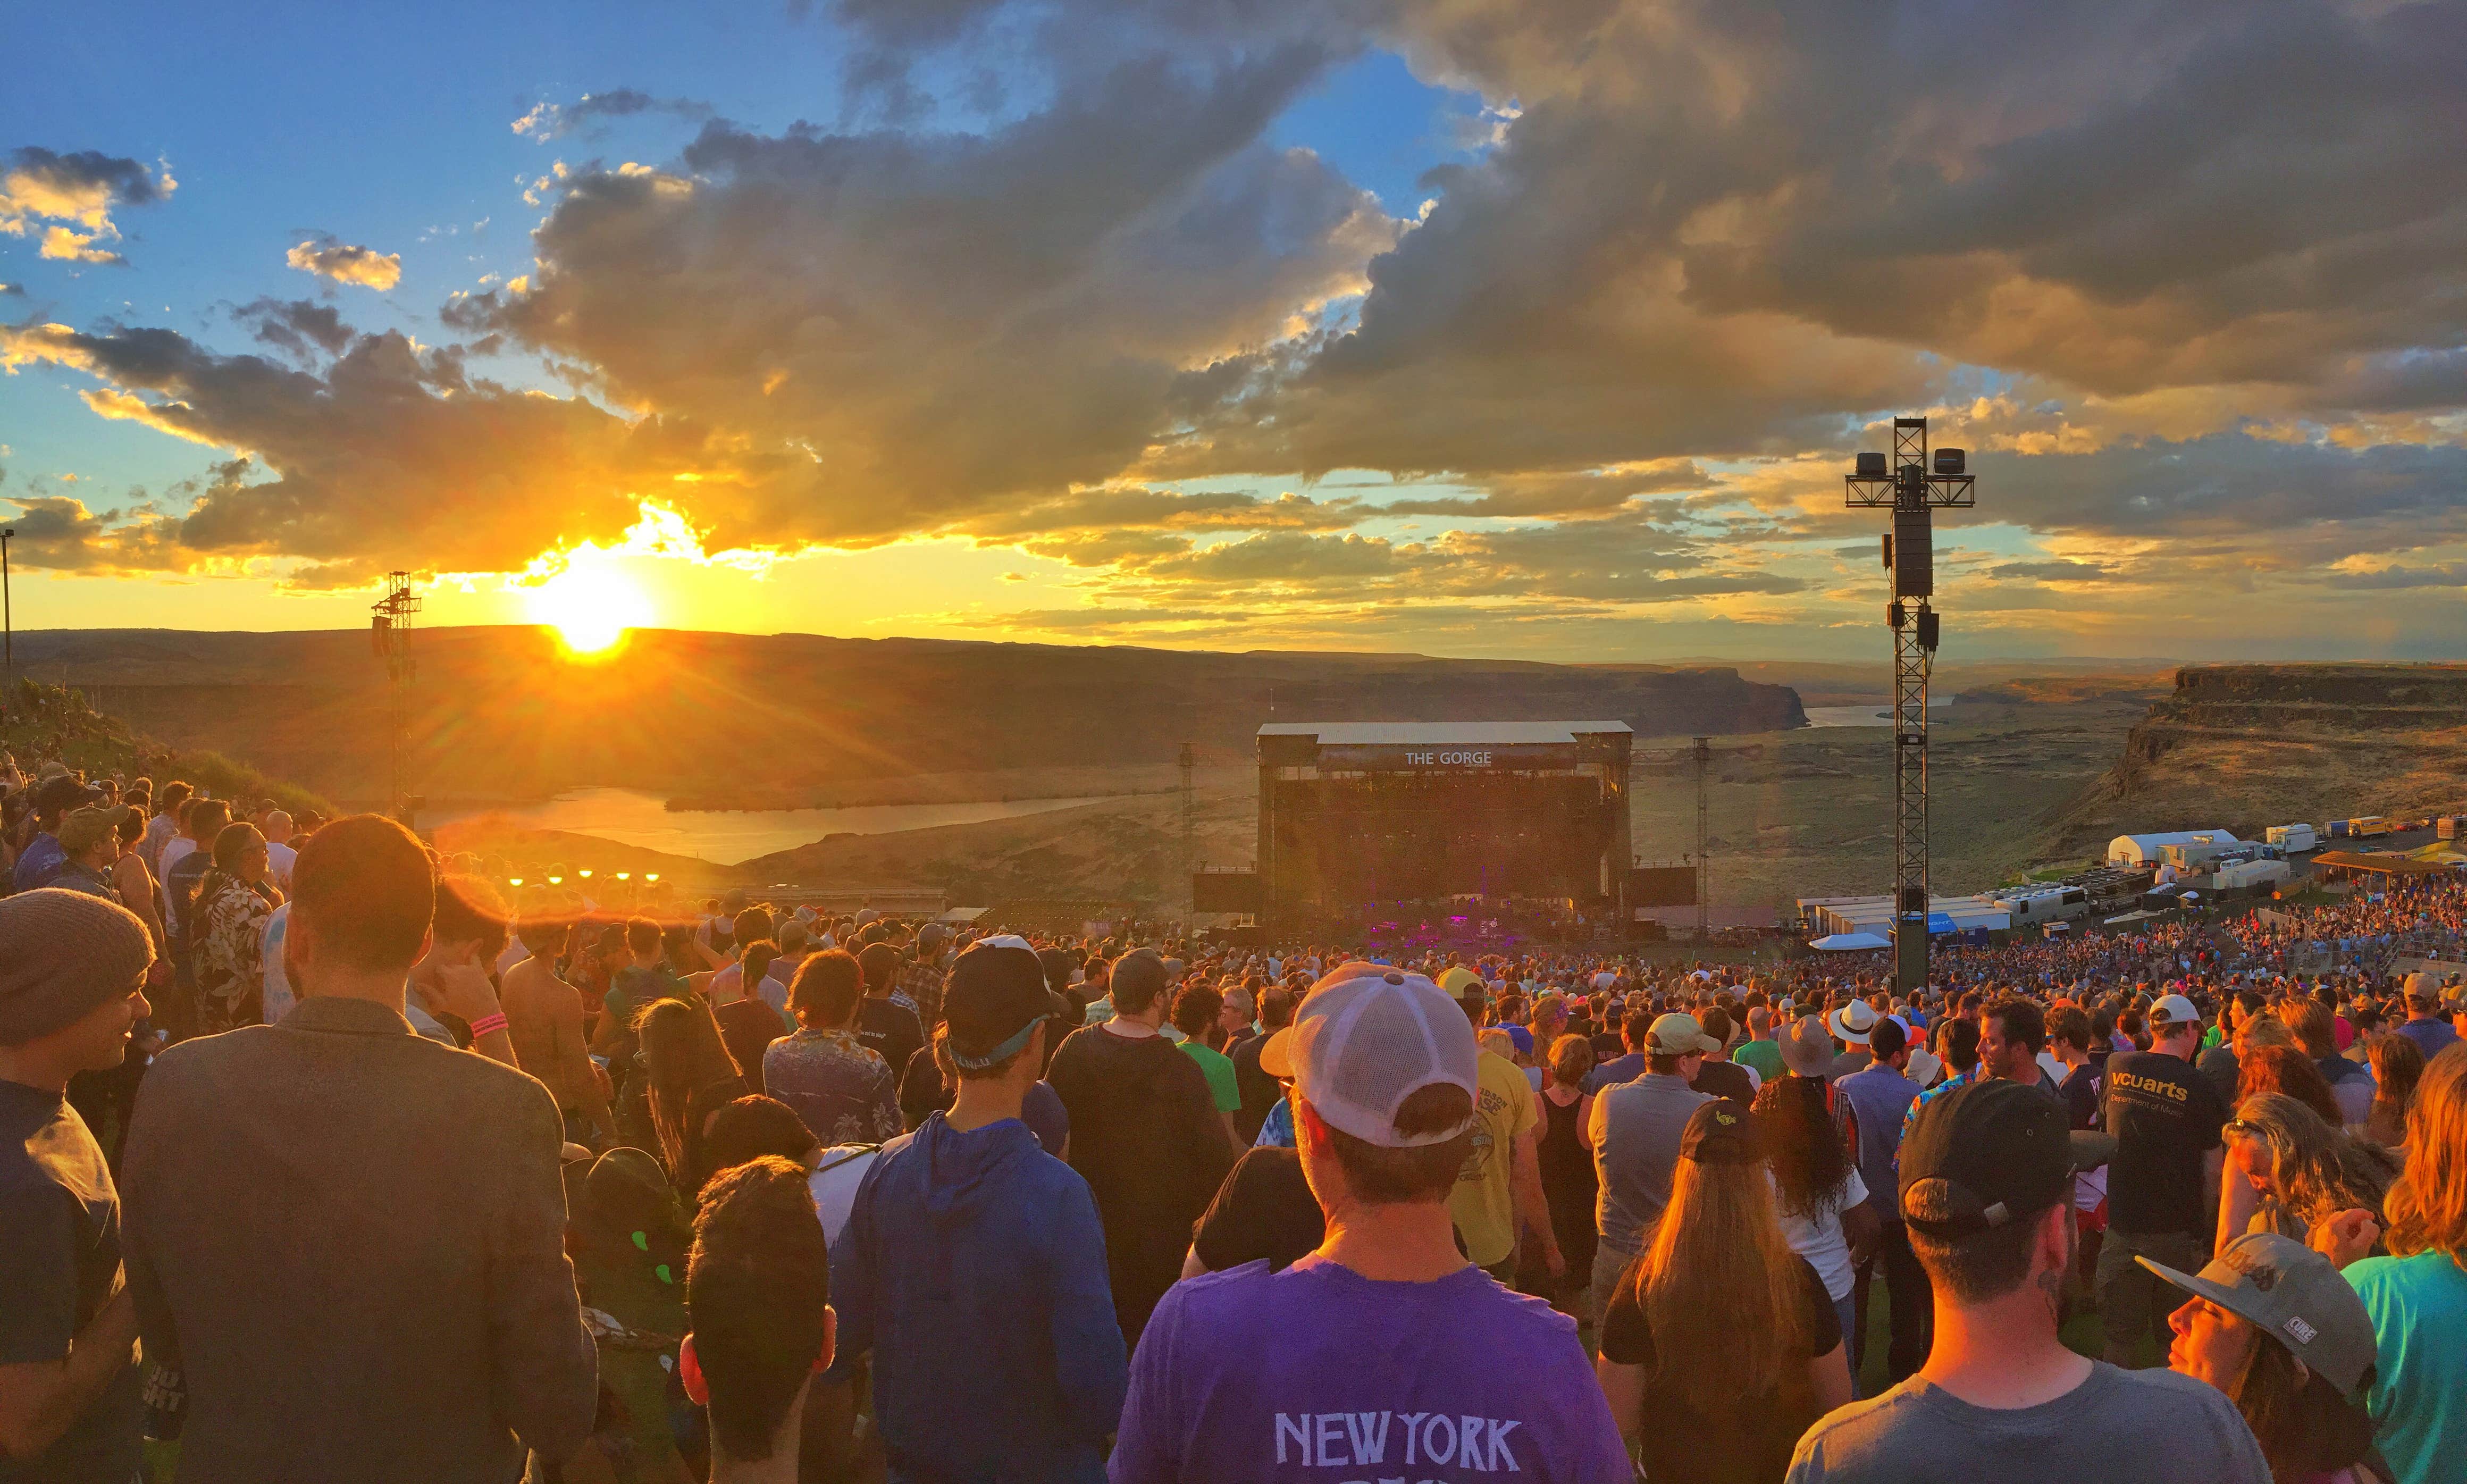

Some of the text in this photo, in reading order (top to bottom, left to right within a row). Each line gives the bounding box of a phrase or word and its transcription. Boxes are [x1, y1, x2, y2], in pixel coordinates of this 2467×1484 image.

[1405, 751, 1492, 765] THE GORGE
[2112, 1072, 2188, 1101] vcuarts
[2111, 1094, 2150, 1109] Department
[2289, 1319, 2314, 1339] CURE
[1275, 1411, 1523, 1472] NEW YORK
